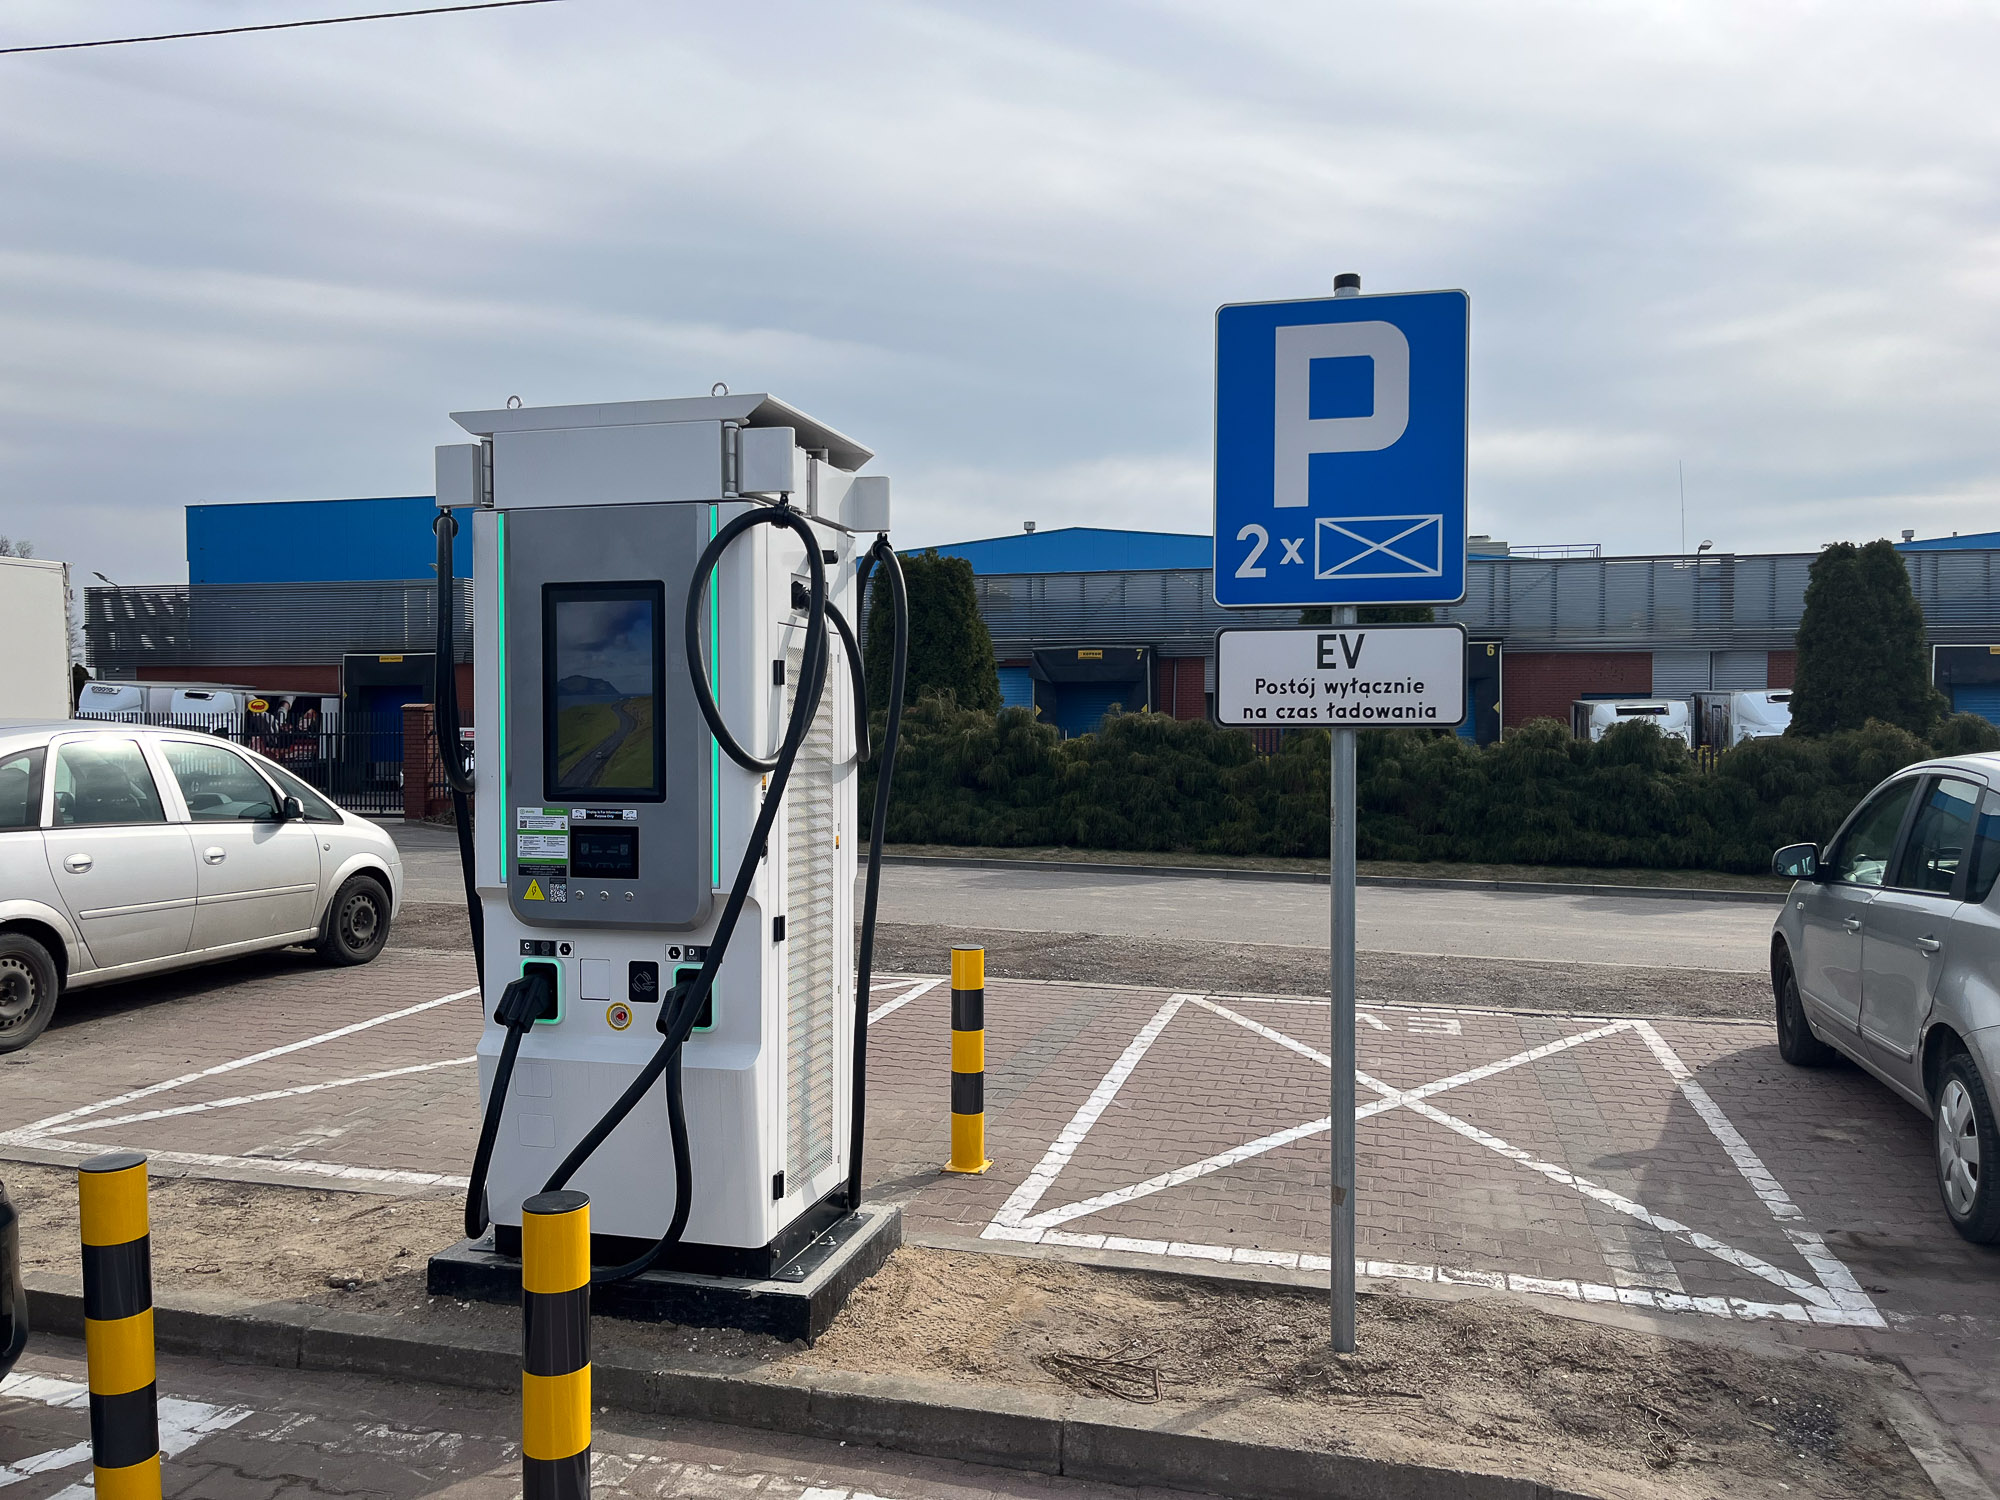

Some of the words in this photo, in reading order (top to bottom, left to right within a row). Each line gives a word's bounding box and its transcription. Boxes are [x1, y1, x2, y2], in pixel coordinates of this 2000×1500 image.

[1273, 320, 1410, 509] P
[1234, 523, 1270, 579] 2
[1279, 537, 1305, 566] x
[1136, 648, 1143, 660] 7
[1316, 633, 1366, 670] EV
[1486, 644, 1495, 656] 6
[1255, 677, 1316, 699] Postój
[1324, 677, 1425, 699] wyłącznie
[1243, 705, 1267, 719] na
[1276, 705, 1318, 719] czas
[1326, 701, 1437, 719] ładowania
[524, 942, 530, 950] C
[688, 948, 695, 956] D
